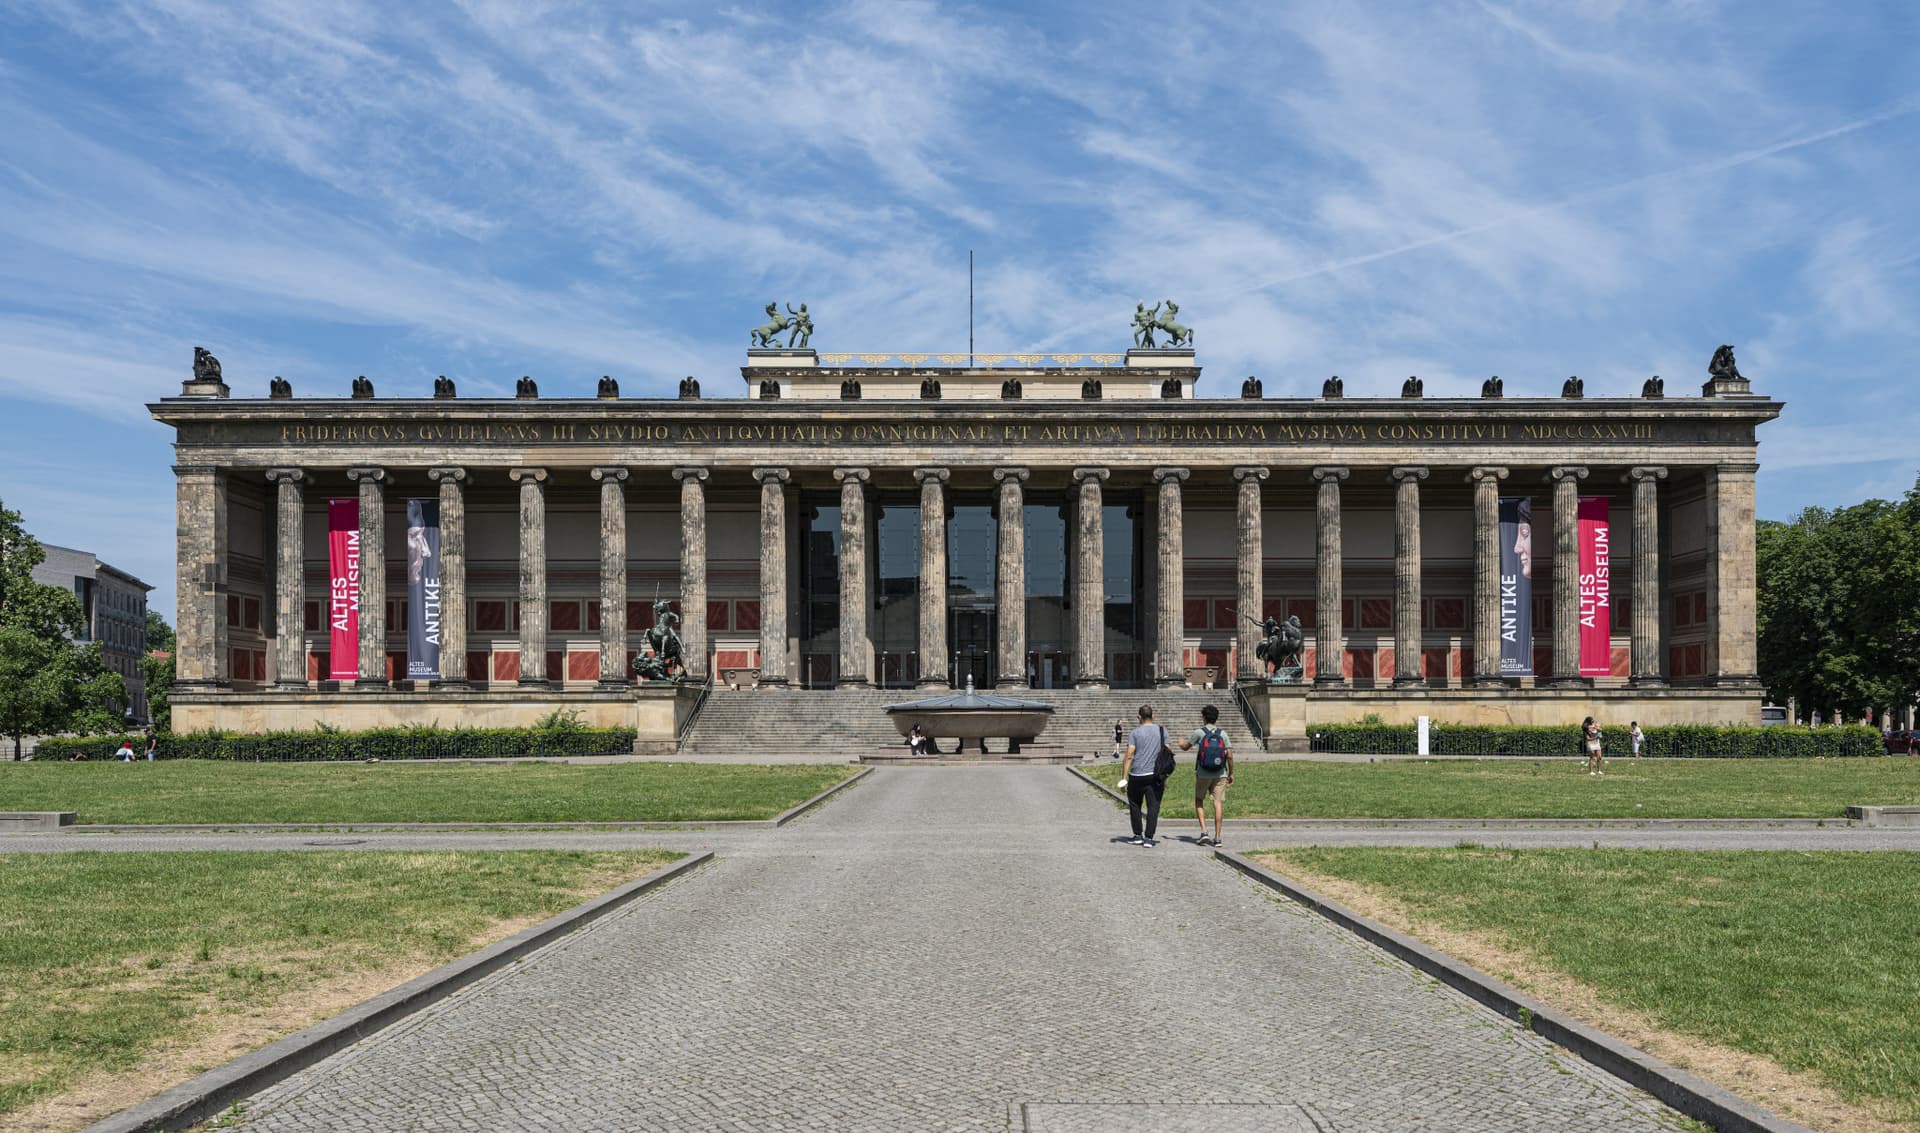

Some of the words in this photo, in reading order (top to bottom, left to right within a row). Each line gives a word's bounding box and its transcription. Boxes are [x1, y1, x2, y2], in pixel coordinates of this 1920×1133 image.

[282, 425, 405, 440] FRIDERICVS
[552, 425, 575, 440] III
[588, 425, 669, 440] STVDIO
[682, 425, 843, 440] ANTIQVITATIS
[854, 425, 993, 440] OMNIGENAE
[1005, 425, 1031, 440] ET
[1040, 425, 1124, 440] ARTIVM
[1135, 425, 1266, 440] LIBERALIVM
[1279, 425, 1366, 440] MVSEVM
[1378, 425, 1509, 440] CONSTITVIT
[1594, 527, 1609, 607] MUSEUM
[332, 577, 348, 632] ALTES
[425, 577, 440, 645] ANTIKE
[1501, 574, 1516, 642] ANTIKE
[1580, 573, 1595, 628] ALTES
